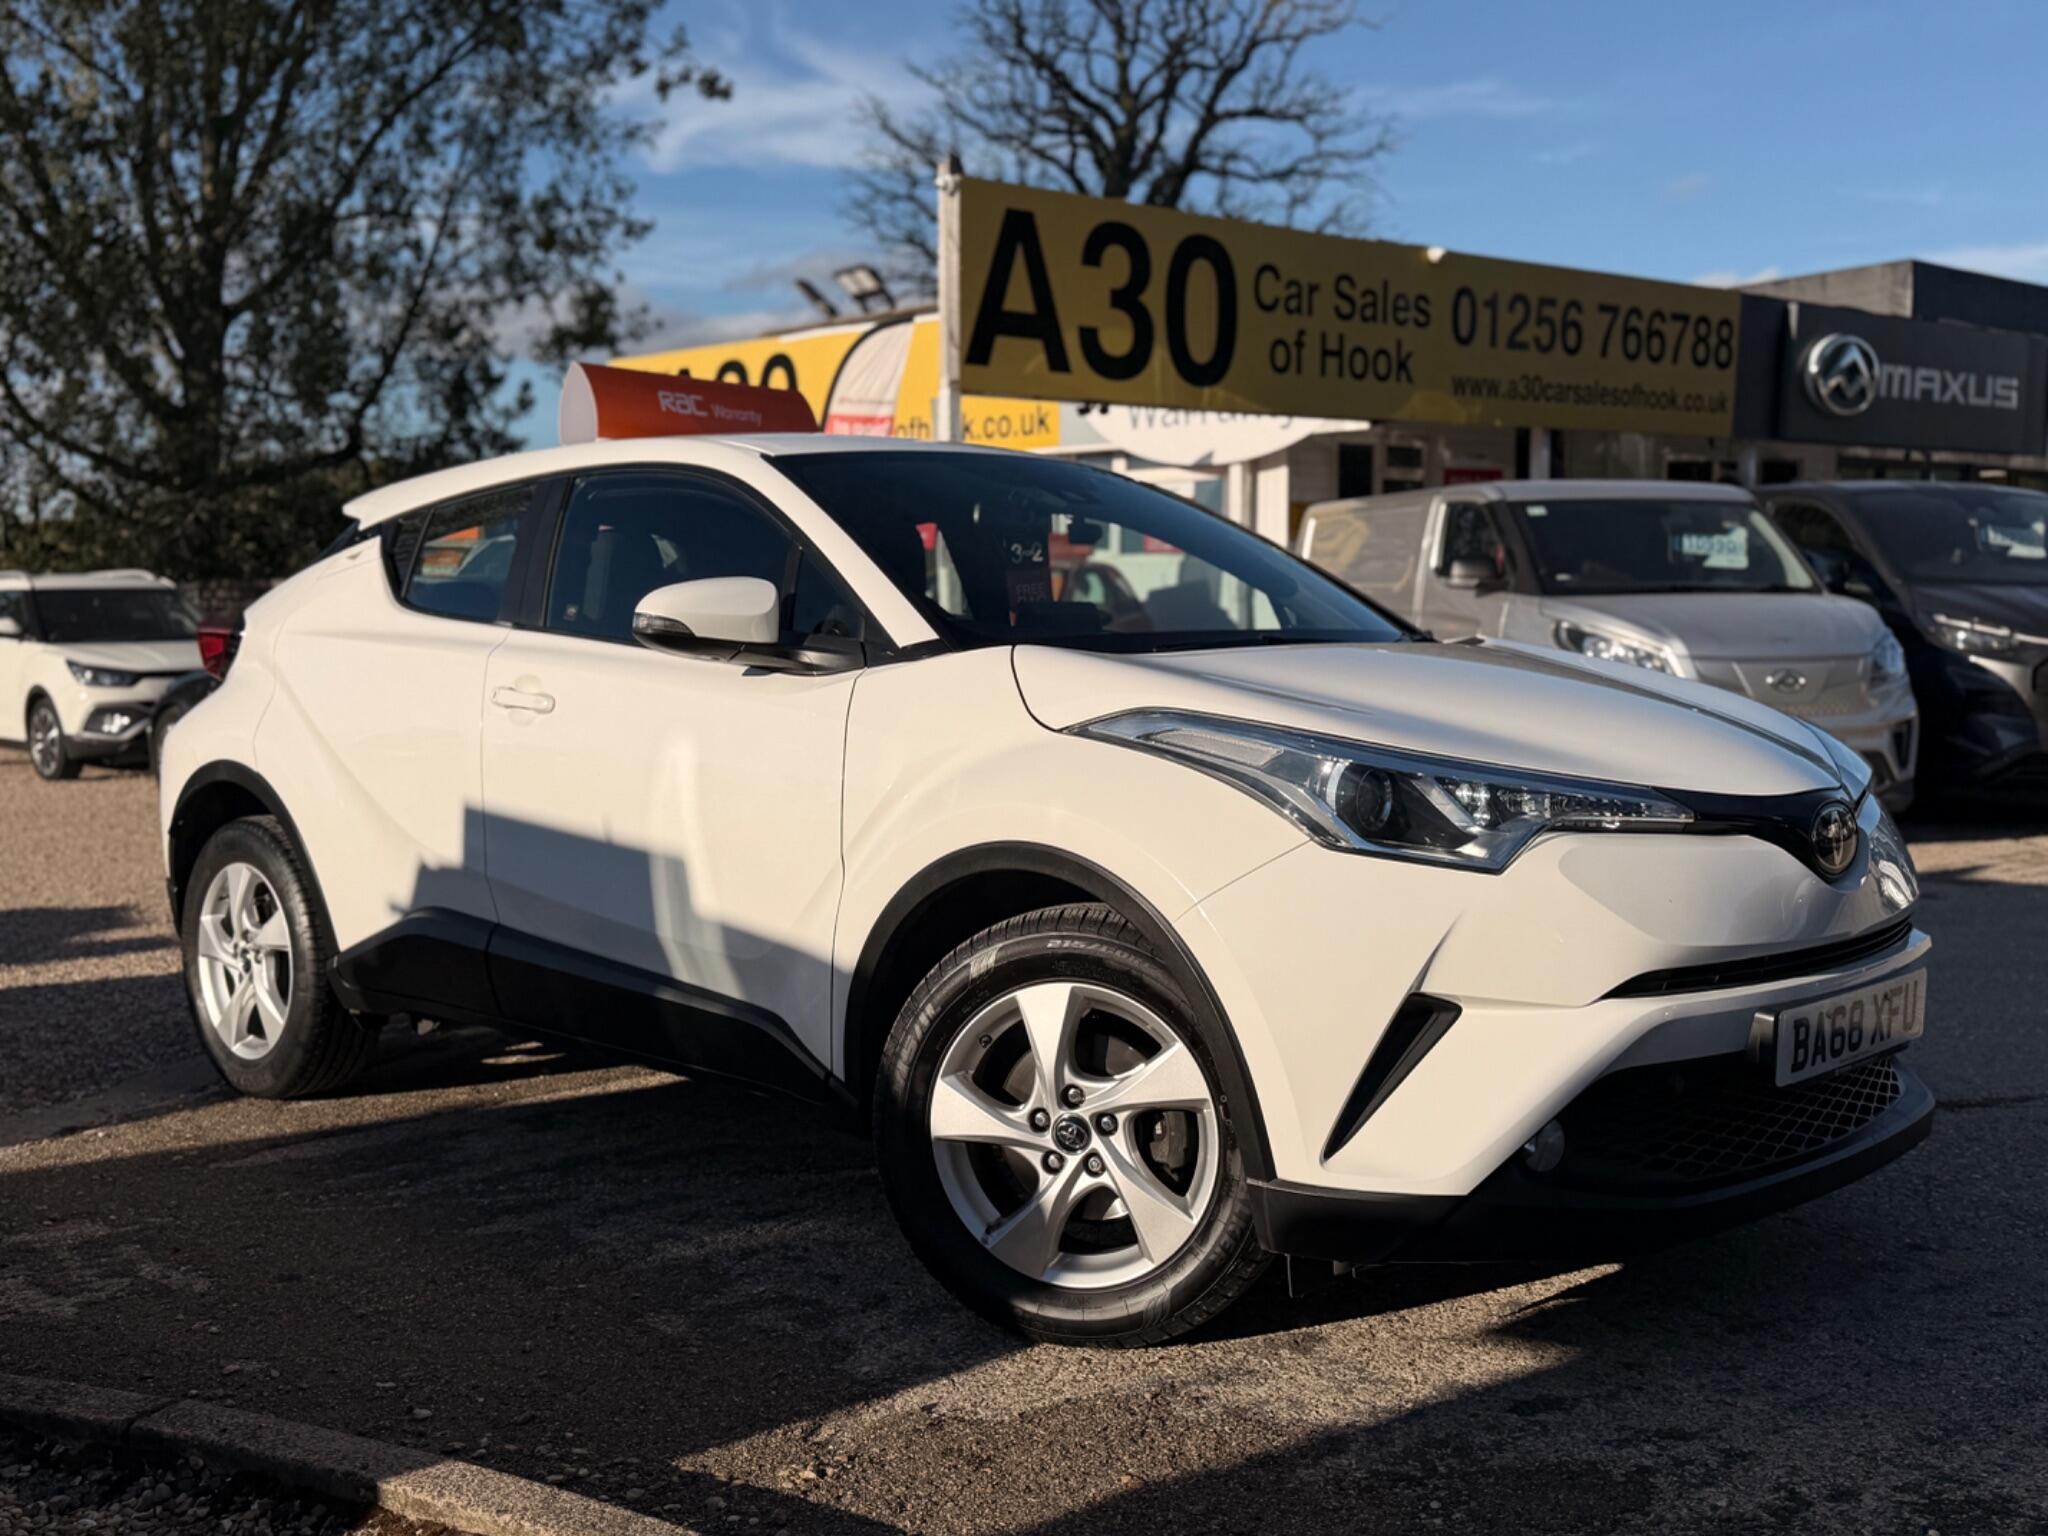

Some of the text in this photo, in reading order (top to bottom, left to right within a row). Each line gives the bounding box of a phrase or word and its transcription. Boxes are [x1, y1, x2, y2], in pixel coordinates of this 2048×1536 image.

[965, 208, 1237, 388] A30
[1254, 264, 1431, 329] Car Sales
[1270, 329, 1413, 384] of Hook
[1452, 286, 1734, 369] 01256 766788
[710, 403, 762, 427] Warranty
[1452, 374, 1728, 414] www.a30carsalesofhook.co.uk
[1879, 363, 2019, 410] MAXUS
[1790, 980, 1918, 1073] BA68 XFU
